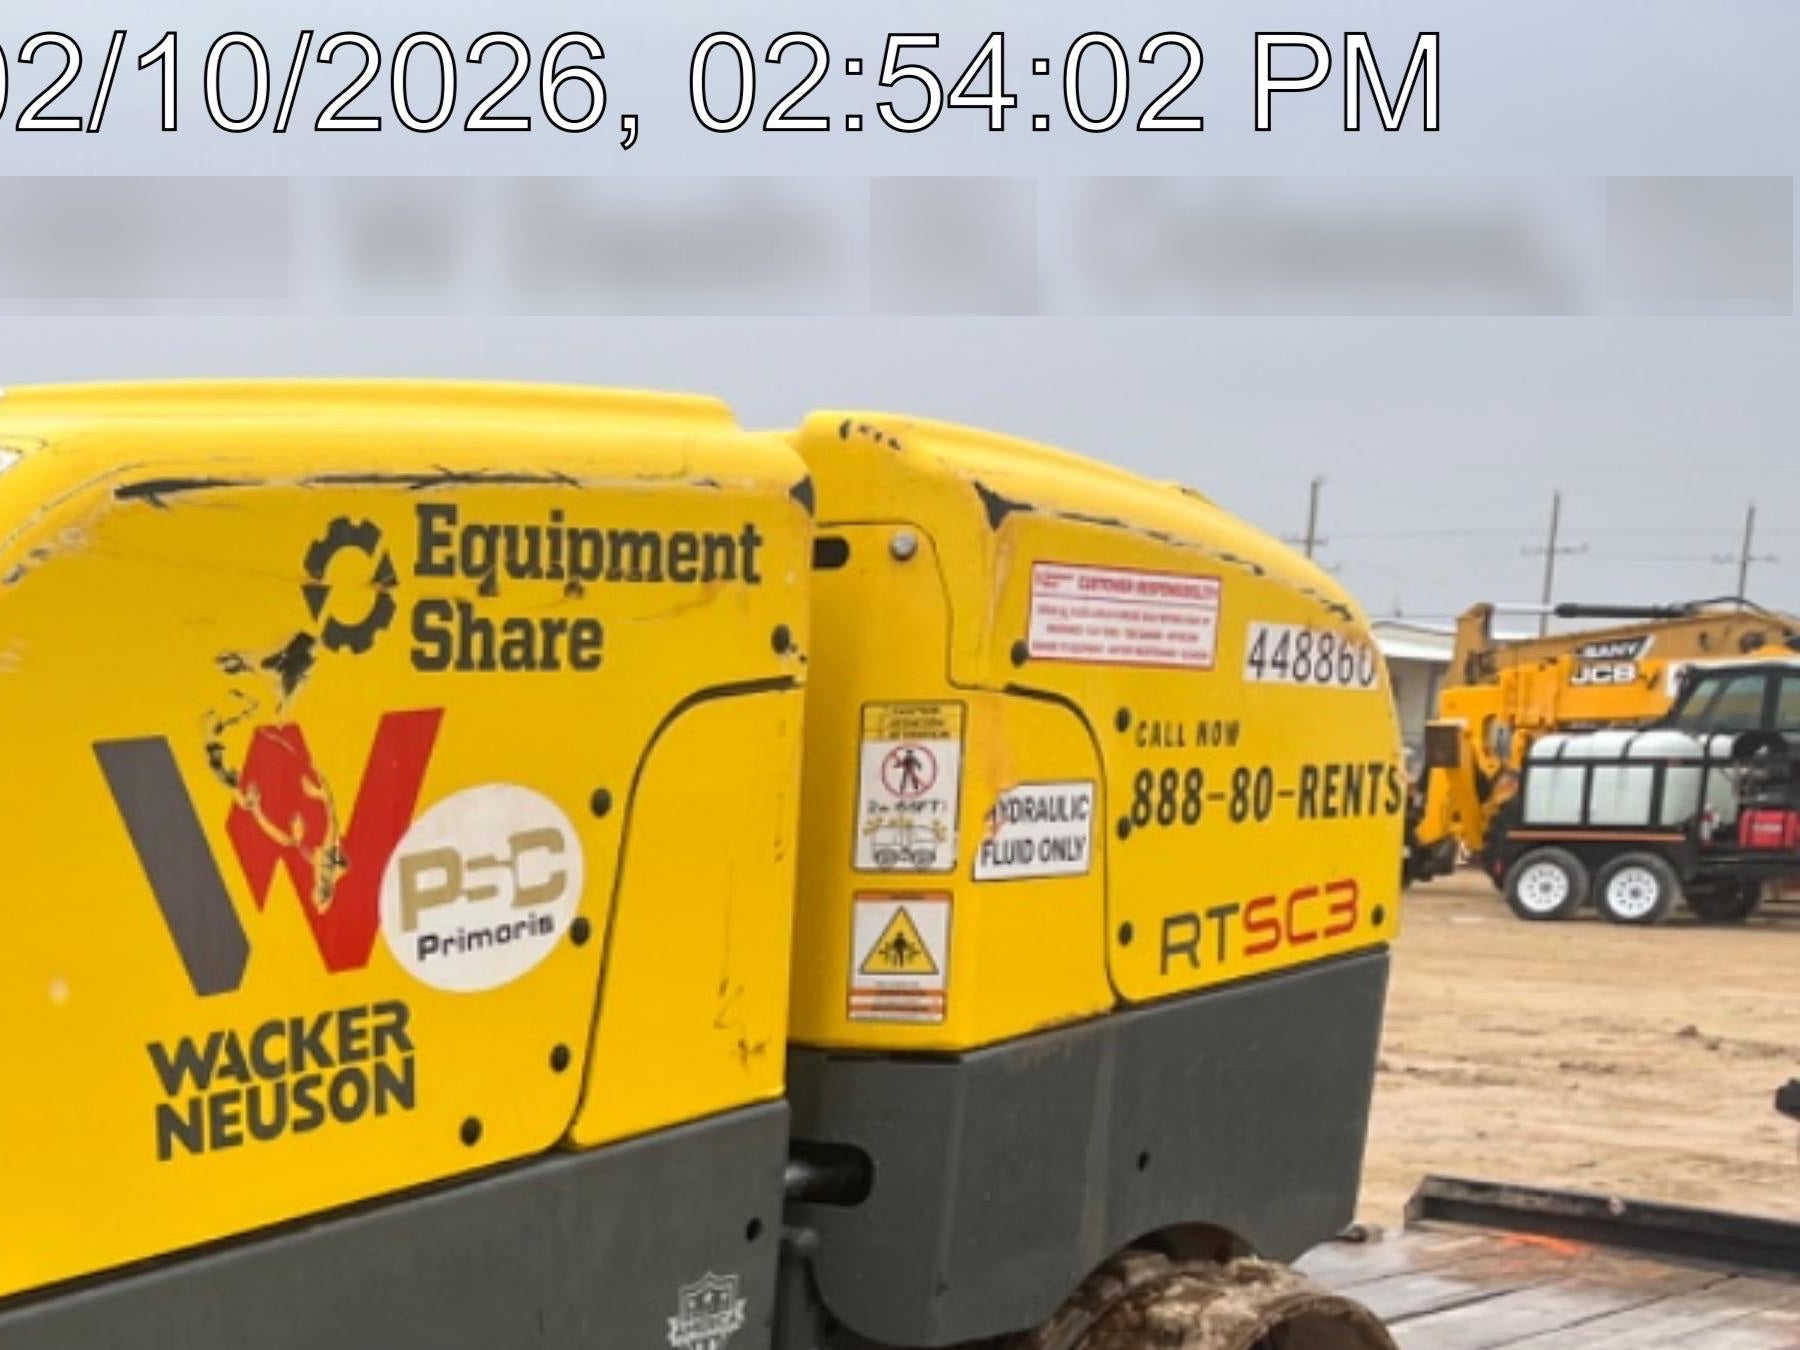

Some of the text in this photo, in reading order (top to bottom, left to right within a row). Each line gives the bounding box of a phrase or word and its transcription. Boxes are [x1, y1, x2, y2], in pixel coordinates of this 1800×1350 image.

[414, 503, 762, 597] Equipment
[411, 600, 603, 672] Share
[1248, 627, 1376, 687] 448860
[1571, 663, 1637, 685] JCB
[1135, 720, 1241, 748] CALL NOW
[1131, 761, 1403, 828] 888-80-RENTS
[981, 835, 1087, 866] FLUID ONLY
[417, 912, 555, 962] Primoris
[1160, 878, 1358, 976] RTSC3
[145, 999, 415, 1098] WACKER
[155, 1055, 415, 1162] NEUSON
